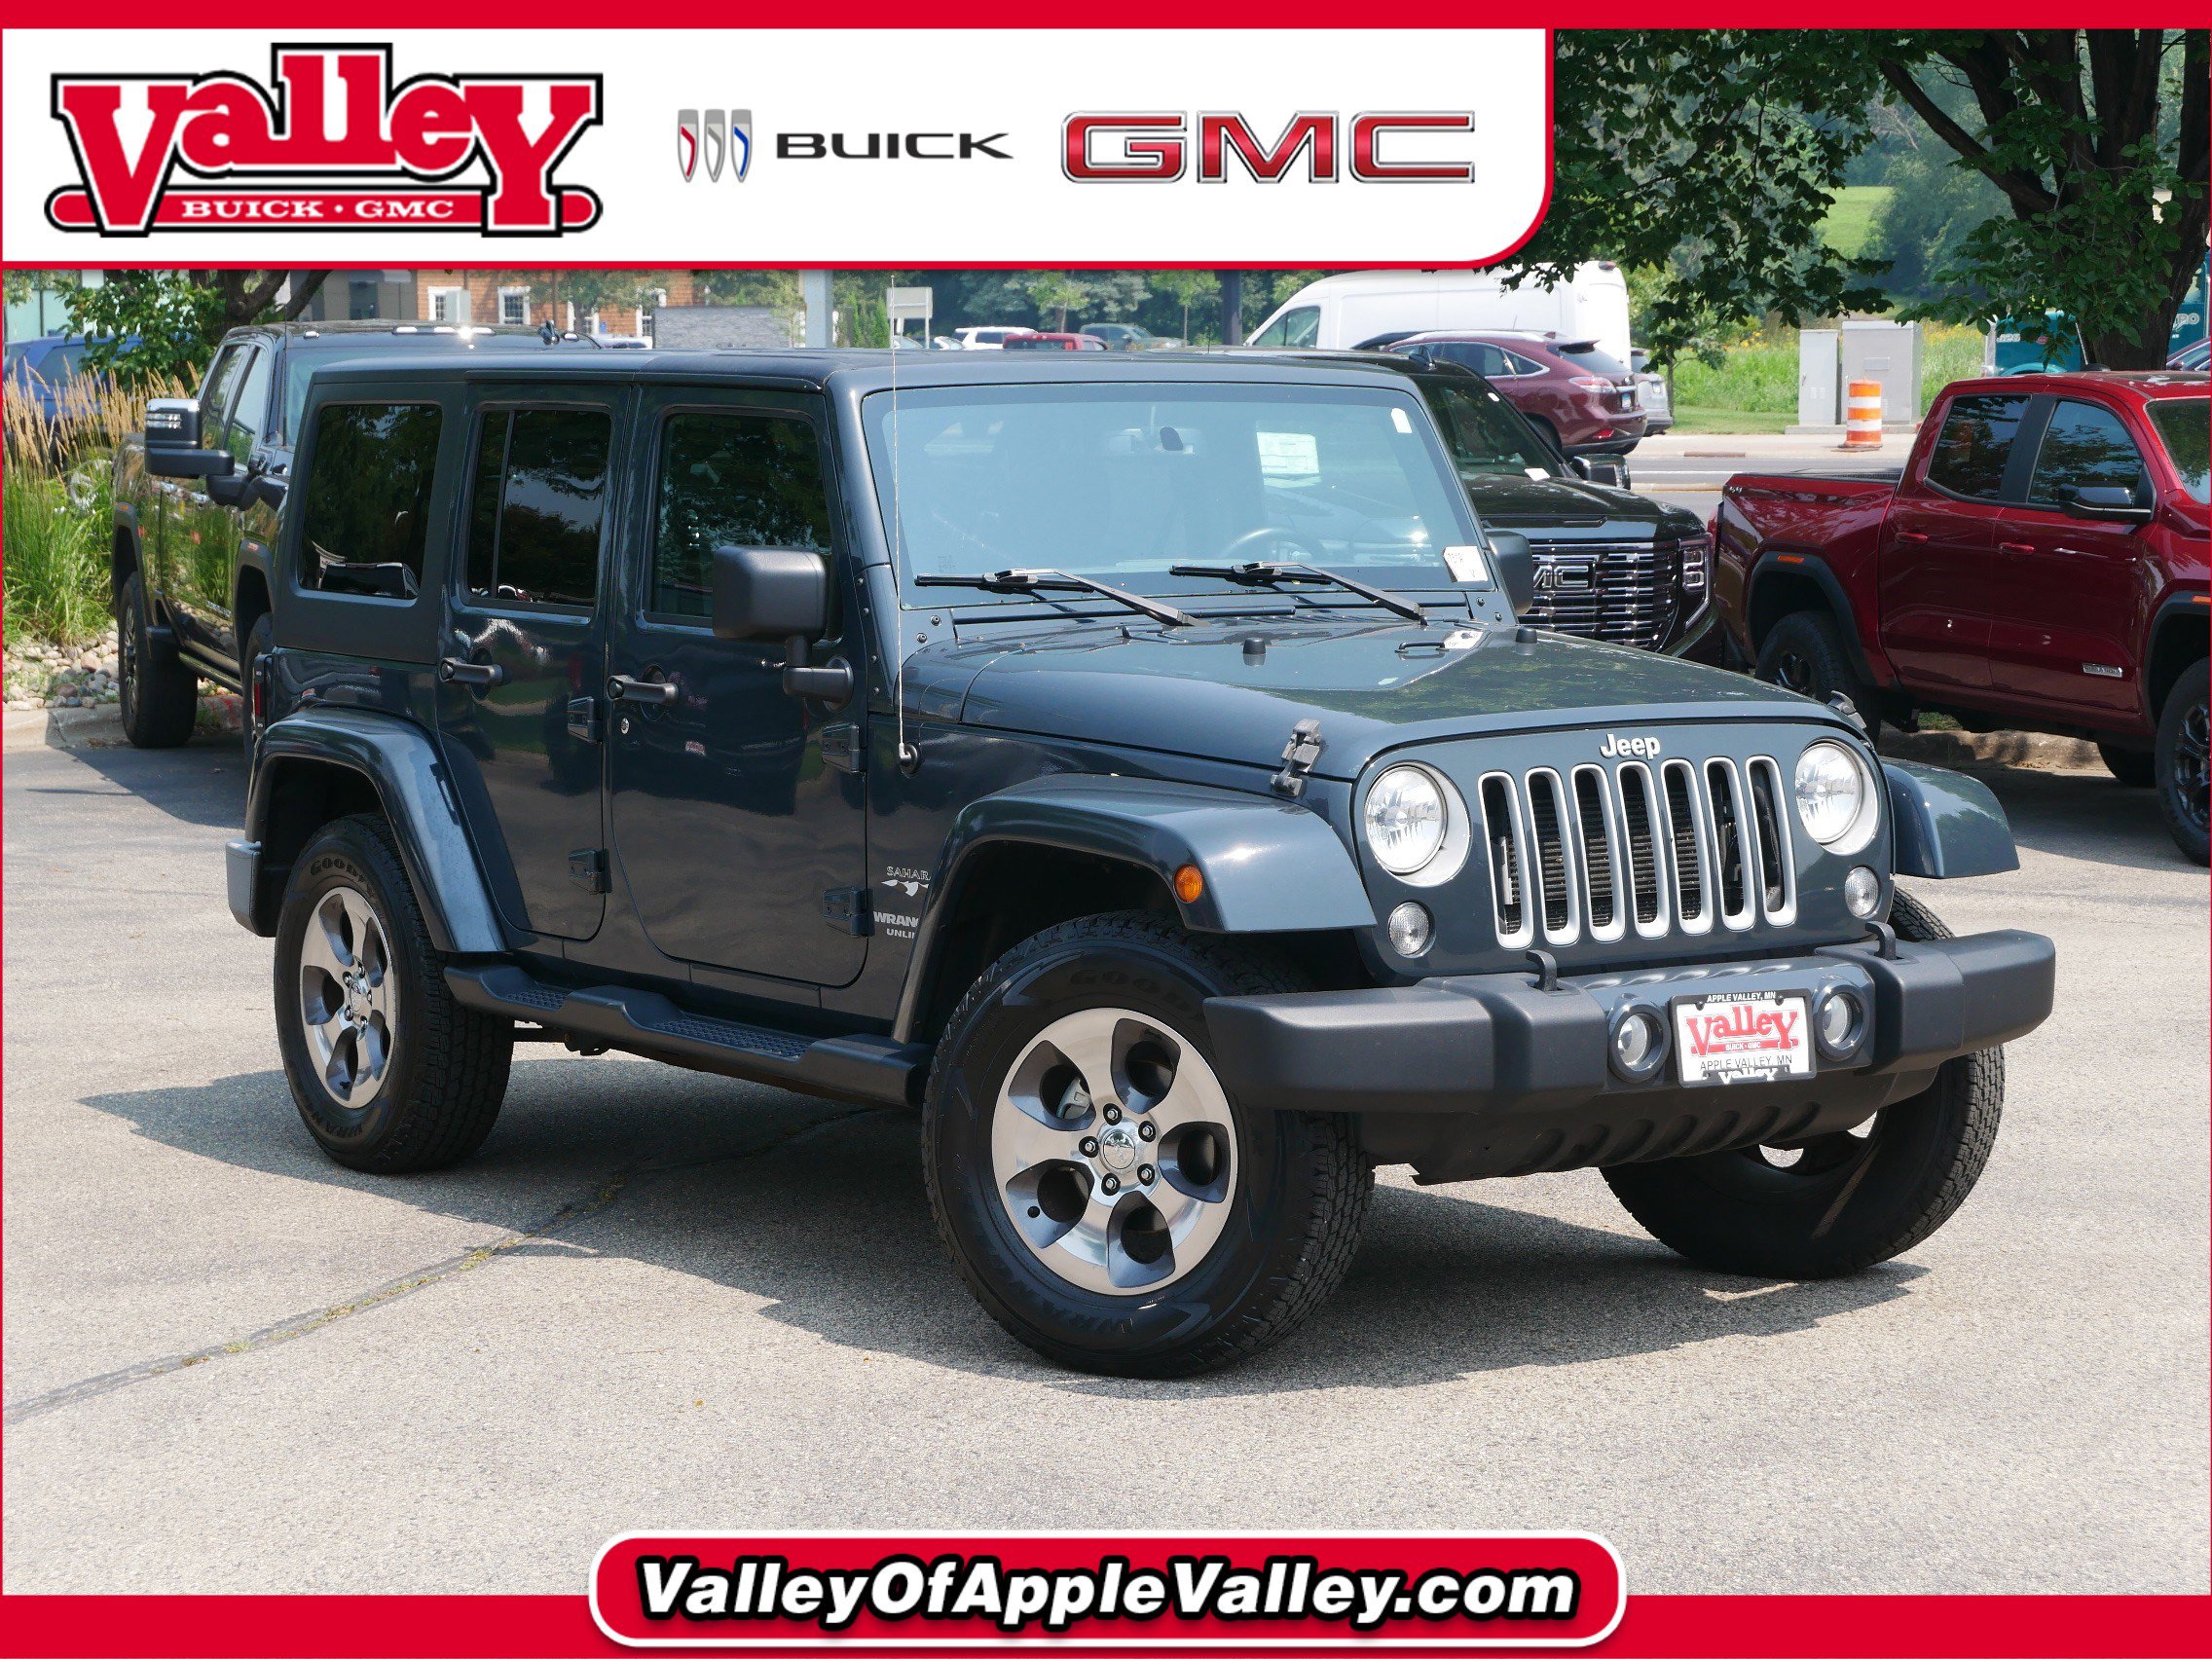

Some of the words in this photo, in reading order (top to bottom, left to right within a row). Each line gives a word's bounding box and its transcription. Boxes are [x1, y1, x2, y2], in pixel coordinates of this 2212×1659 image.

[1533, 565, 1589, 588] MC
[1600, 733, 1661, 759] Jeep
[887, 866, 932, 881] SAHAR
[1707, 993, 1732, 1003] APPLE
[1733, 992, 1763, 1003] VALLEY,
[1764, 991, 1777, 1000] MN
[1685, 1004, 1798, 1056] Valley
[1700, 1058, 1732, 1070] APPLE
[1776, 1054, 1792, 1065] MN
